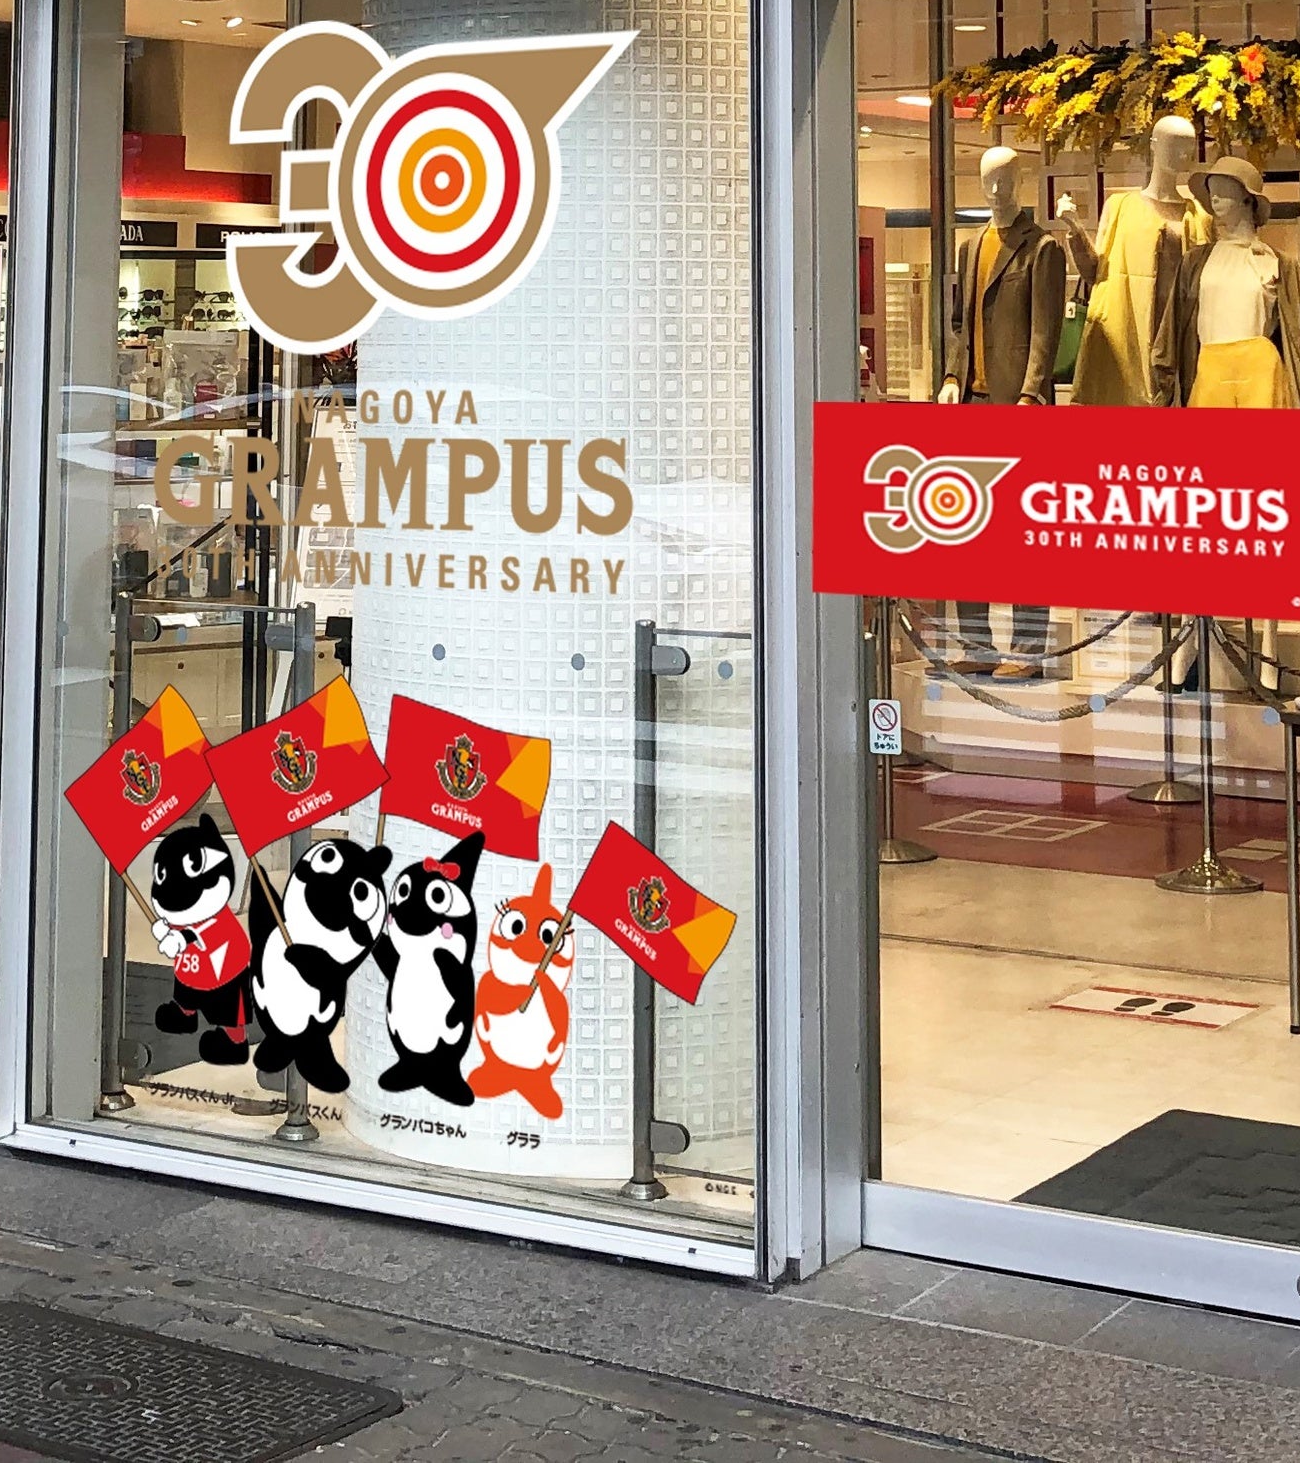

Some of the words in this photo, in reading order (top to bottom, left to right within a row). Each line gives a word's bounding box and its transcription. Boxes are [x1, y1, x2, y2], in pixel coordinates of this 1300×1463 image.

[292, 389, 479, 425] NAGOYA
[153, 433, 635, 536] GRAMPUS
[1098, 464, 1204, 483] NAGOYA
[1020, 481, 1290, 532] GRAMPUS
[1024, 530, 1083, 548] 30TH
[1096, 532, 1287, 558] ANNIVERSARY
[155, 544, 256, 583] 30TH
[281, 553, 626, 595] ANNIVERSARY
[141, 795, 179, 833] GRAMPUS
[287, 791, 333, 823] GRAMPUS
[431, 803, 483, 829] GRAMPUS
[614, 918, 657, 961] GRAMPUS
[175, 953, 200, 974] 758
[506, 1131, 541, 1150] グララ
